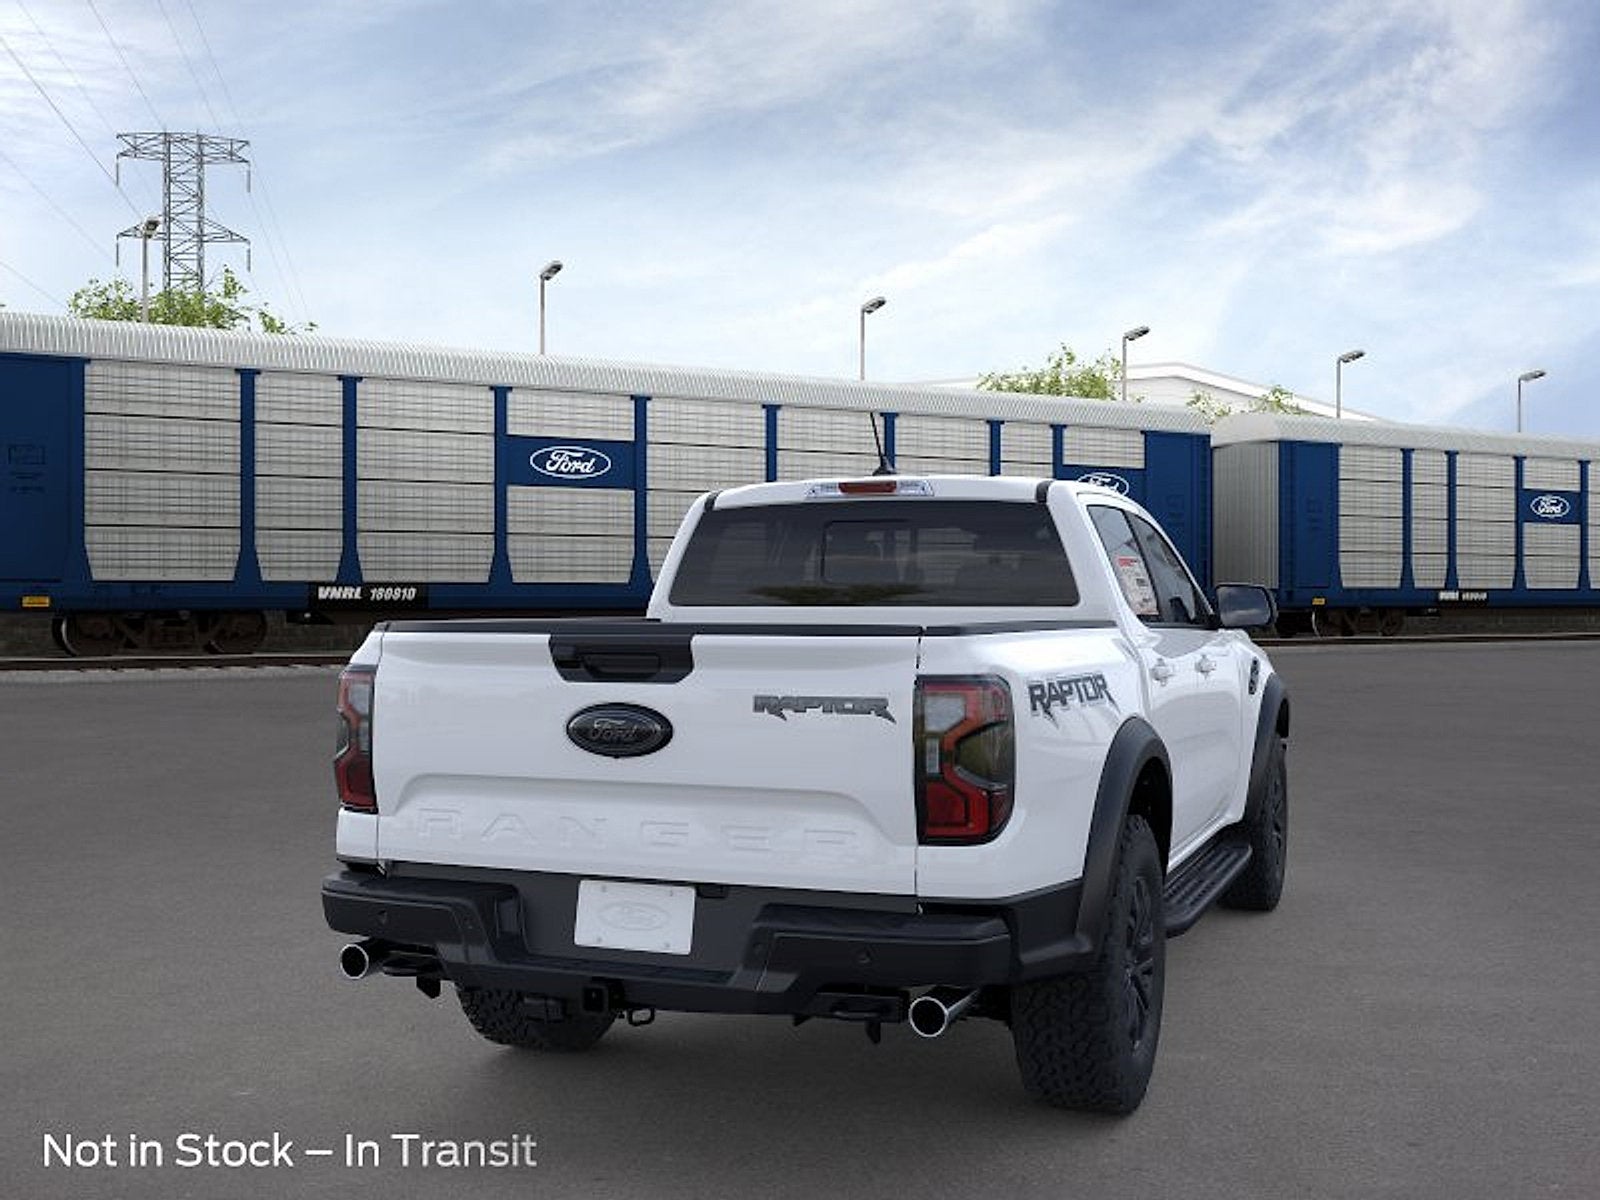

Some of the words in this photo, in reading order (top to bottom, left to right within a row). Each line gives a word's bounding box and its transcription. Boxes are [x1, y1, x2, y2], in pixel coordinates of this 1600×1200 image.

[546, 450, 595, 473] Ford
[752, 696, 898, 725] RAPTOR
[1027, 674, 1121, 730] RAPTOR
[591, 718, 639, 741] Ford
[415, 806, 862, 857] RANGER
